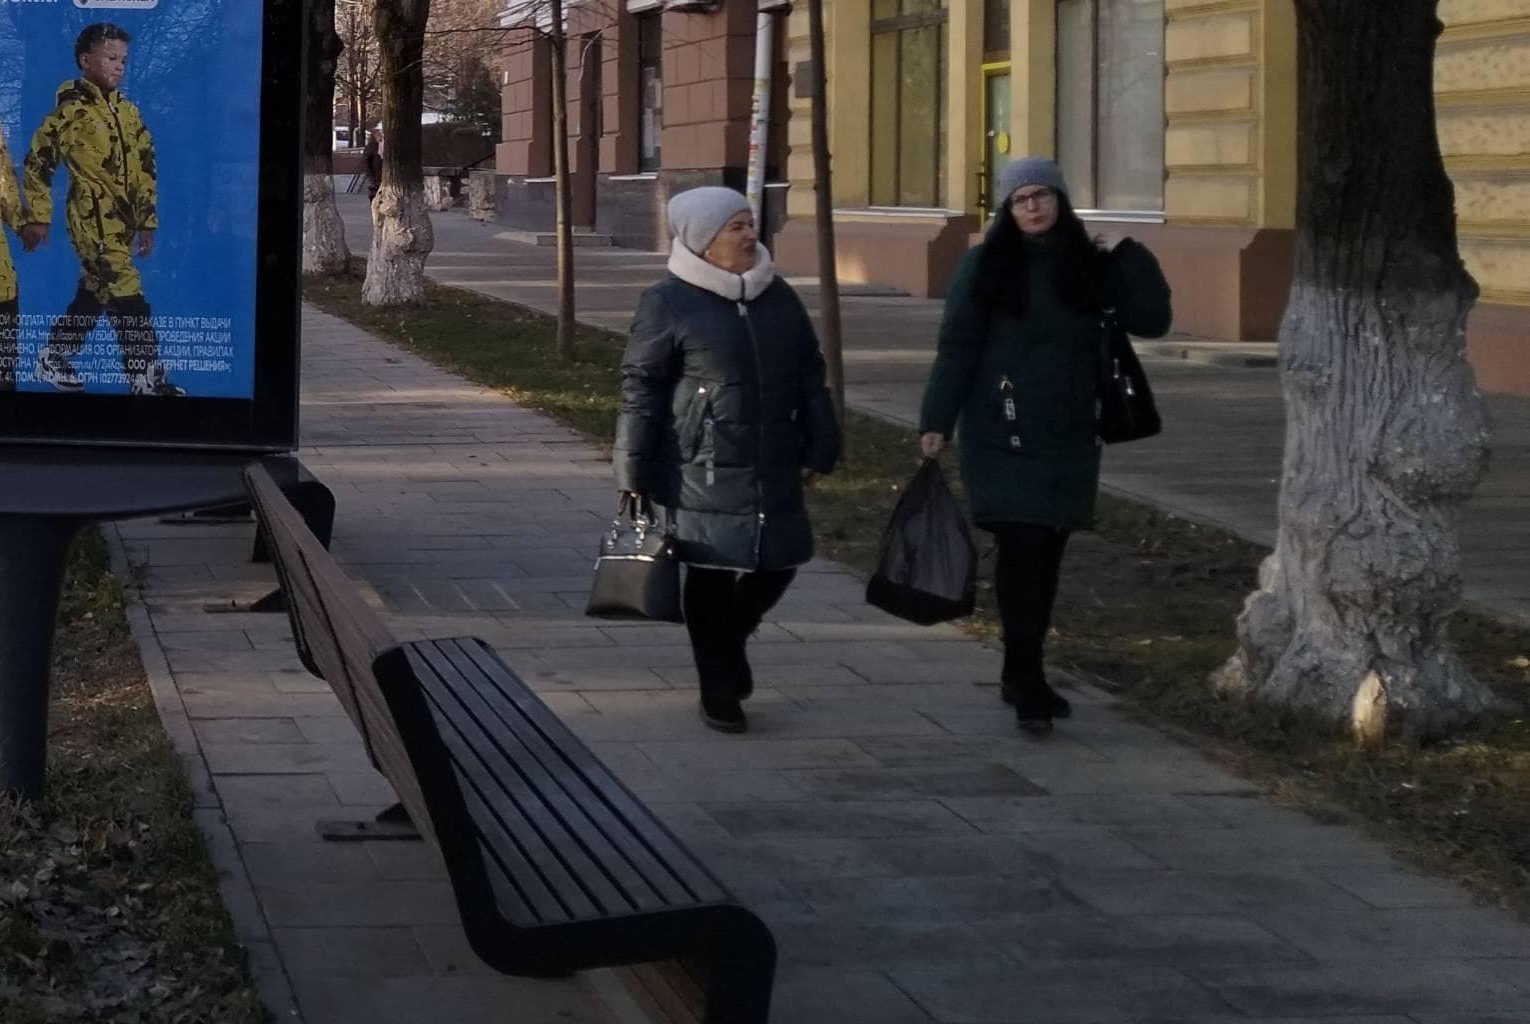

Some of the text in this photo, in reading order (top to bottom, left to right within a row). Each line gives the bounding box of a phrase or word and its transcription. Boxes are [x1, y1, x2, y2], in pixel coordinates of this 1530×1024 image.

[46, 315, 72, 327] ПОСЛЕ
[123, 316, 138, 327] ПРИ
[139, 316, 167, 328] ЗАКАЗЕ
[175, 317, 200, 329] ПУНКТ
[200, 317, 231, 330] ВЫДАЧИ
[155, 330, 204, 343] ПРОВЕДЕНИЯ
[193, 346, 233, 357] ПРАВИЛАХ
[127, 359, 146, 370] ООО
